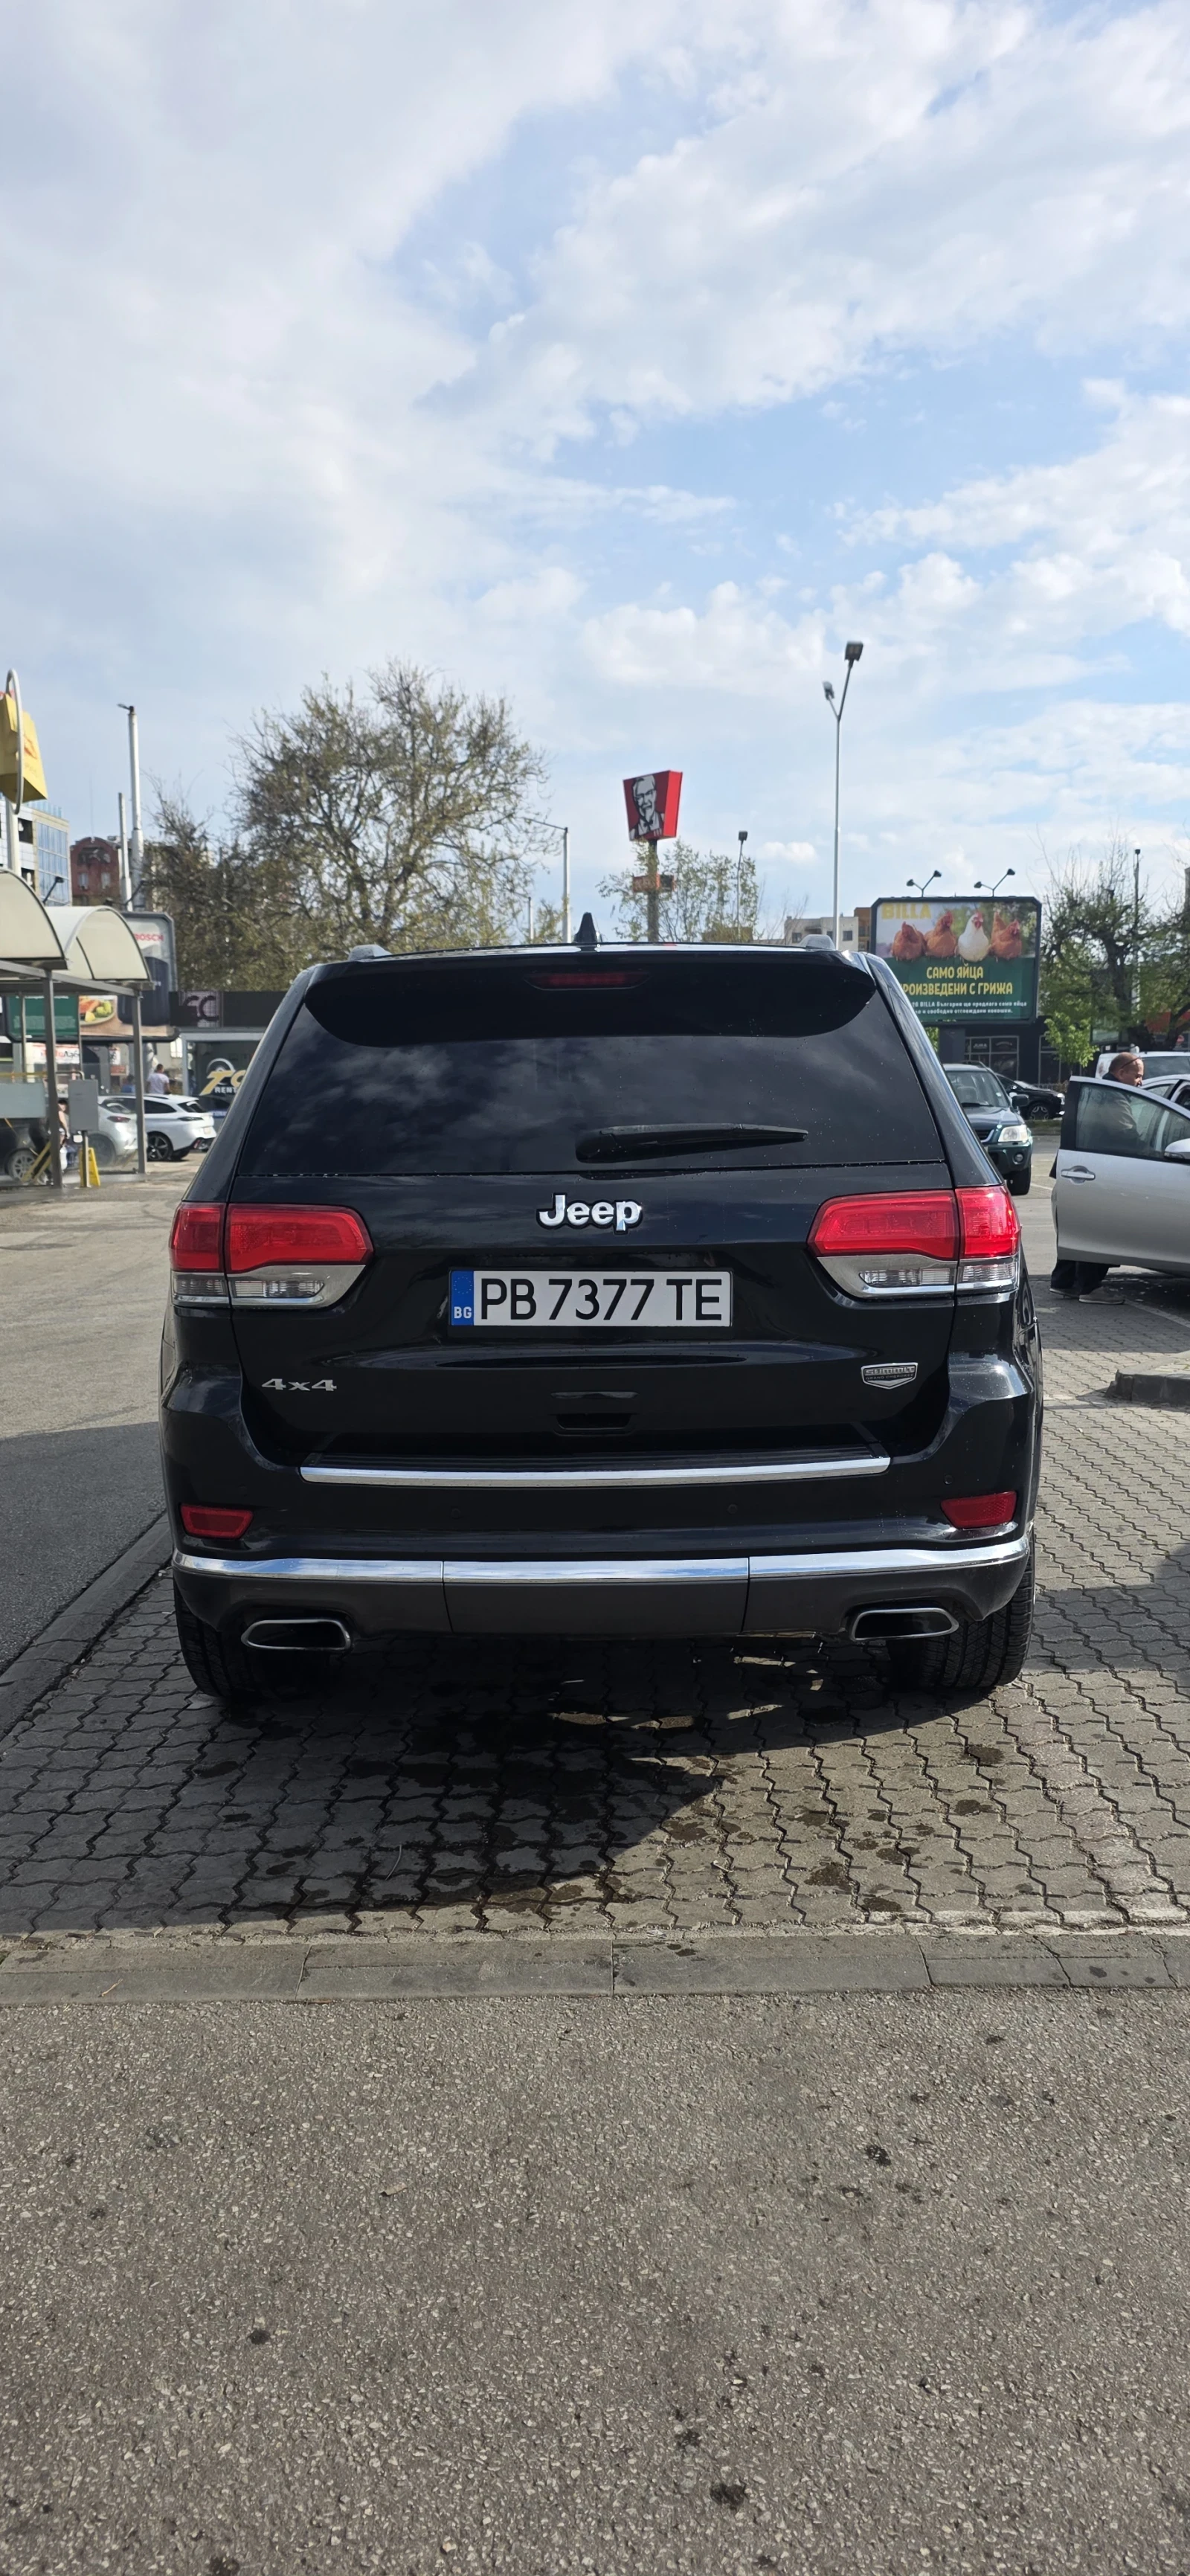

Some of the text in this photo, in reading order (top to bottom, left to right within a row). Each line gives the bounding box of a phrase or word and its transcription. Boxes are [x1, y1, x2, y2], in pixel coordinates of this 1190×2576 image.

[881, 903, 931, 919] BILLA
[926, 963, 984, 980] САМО ЯЙЦА
[901, 982, 1013, 997] РОИЗВЕДЕНИ С ГРИЖА
[538, 1194, 643, 1232] Jeep
[480, 1278, 722, 1321] PB 7377 TE
[454, 1306, 472, 1319] BG
[261, 1378, 337, 1392] 4x4
